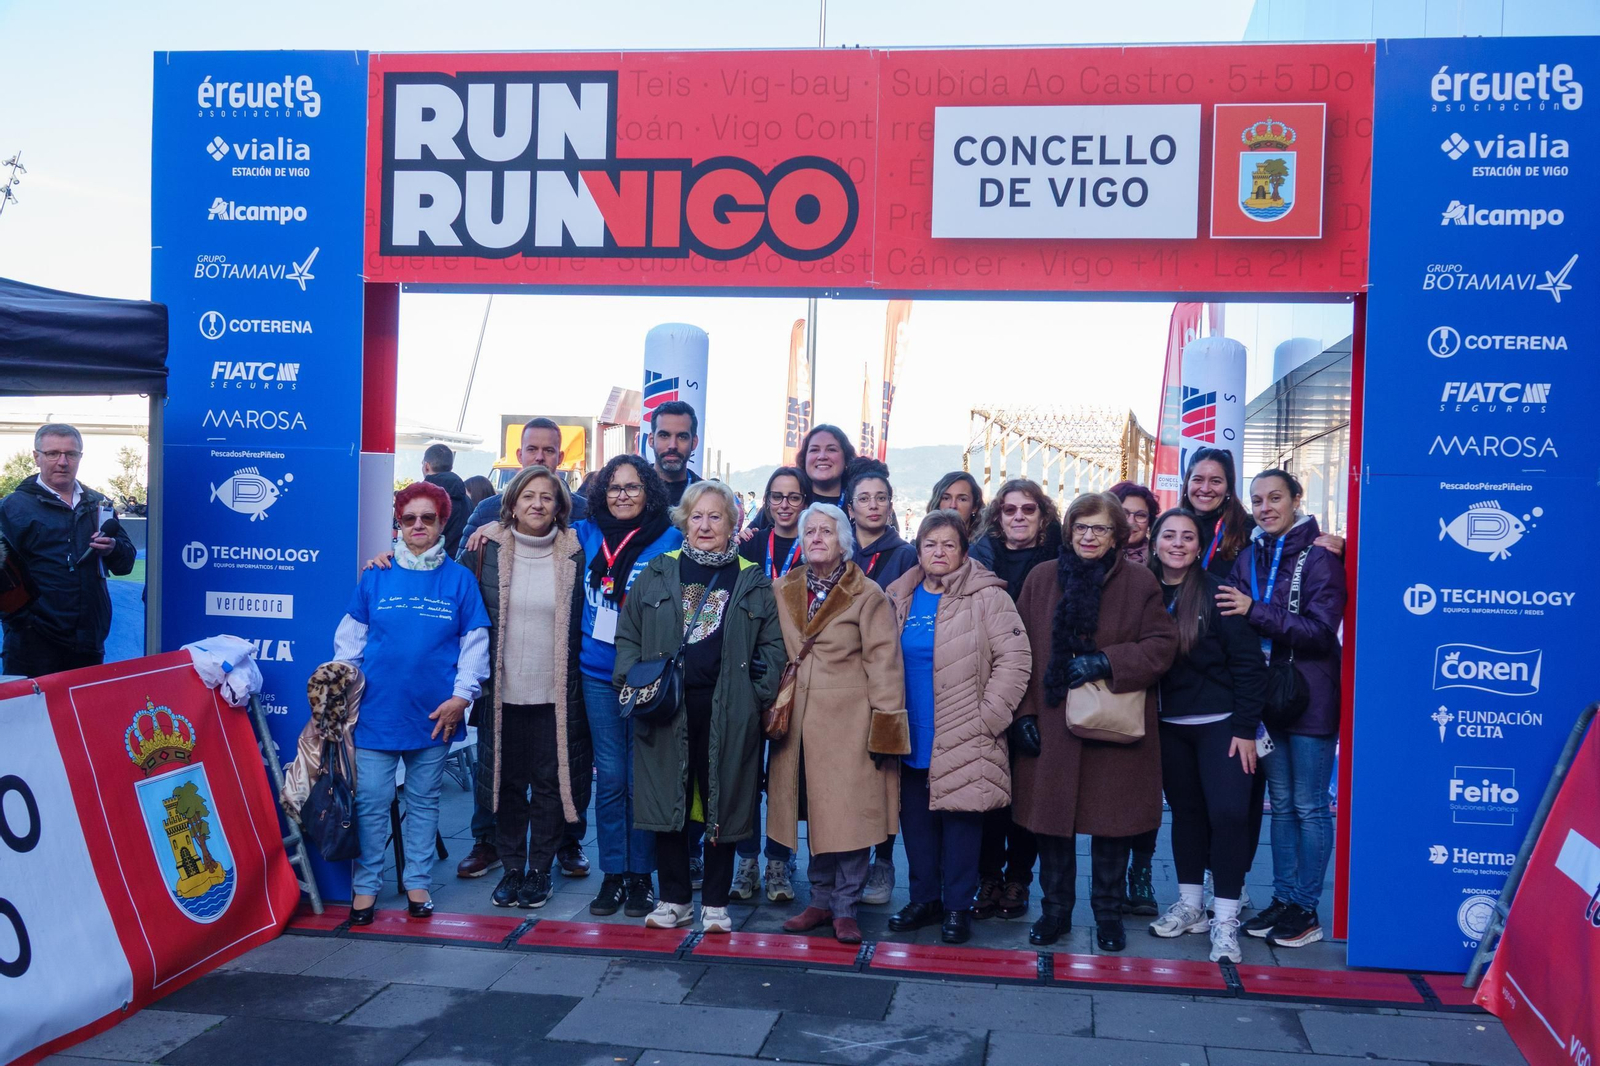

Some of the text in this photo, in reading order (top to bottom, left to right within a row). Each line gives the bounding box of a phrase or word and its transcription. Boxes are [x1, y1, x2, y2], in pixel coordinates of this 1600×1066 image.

[630, 69, 850, 103] Teis Vig-bay
[892, 66, 1194, 97] Subida Ao Castro
[1227, 64, 1294, 93] 5+5
[395, 83, 608, 162] RUN
[711, 113, 783, 147] Vigo
[233, 137, 310, 160] vialia
[954, 135, 1176, 166] CONCELLO
[1474, 133, 1569, 158] vialia
[232, 166, 310, 177] ESTACIÓN DE VIGO
[1473, 165, 1568, 176] ESTACIÓN DE VIGO
[980, 177, 1148, 207] DE VIGO
[208, 198, 307, 225] Alcampo
[1441, 200, 1564, 229] Alcampo
[197, 255, 226, 263] GRUPO
[887, 248, 1007, 276] Cáncer
[1039, 249, 1114, 284] Vigo
[1213, 249, 1252, 277] La
[194, 264, 285, 279] BOTAMAVI
[1427, 264, 1462, 272] GRUPO
[1423, 274, 1537, 290] BOTAMAVI
[229, 319, 312, 333] COTERENA
[1465, 335, 1567, 350] COTERENA
[211, 361, 275, 381] FIATC
[211, 380, 297, 390] SEGUROS
[1441, 382, 1521, 403] FIATC
[1440, 404, 1545, 413] SEGUROS
[203, 410, 306, 430] MAROSA
[1429, 436, 1558, 457] MAROSA
[1440, 482, 1532, 491] PescadosPérezPiñeiro
[212, 546, 319, 562] TECHNOLOGY
[213, 562, 236, 570] EQUIPOS
[236, 563, 274, 571] INFORMÁTICOS
[217, 596, 283, 613] verdecora
[1440, 589, 1575, 605] TECHNOLOGY
[1443, 607, 1470, 615] EQUIPOS
[1471, 607, 1518, 615] INFORMÁTICOS
[1524, 609, 1545, 617] REDES
[1458, 710, 1542, 726] FUNDACIÓN
[1457, 725, 1503, 738] CELTA
[1450, 779, 1519, 803] Feito
[1453, 848, 1516, 865] Herma
